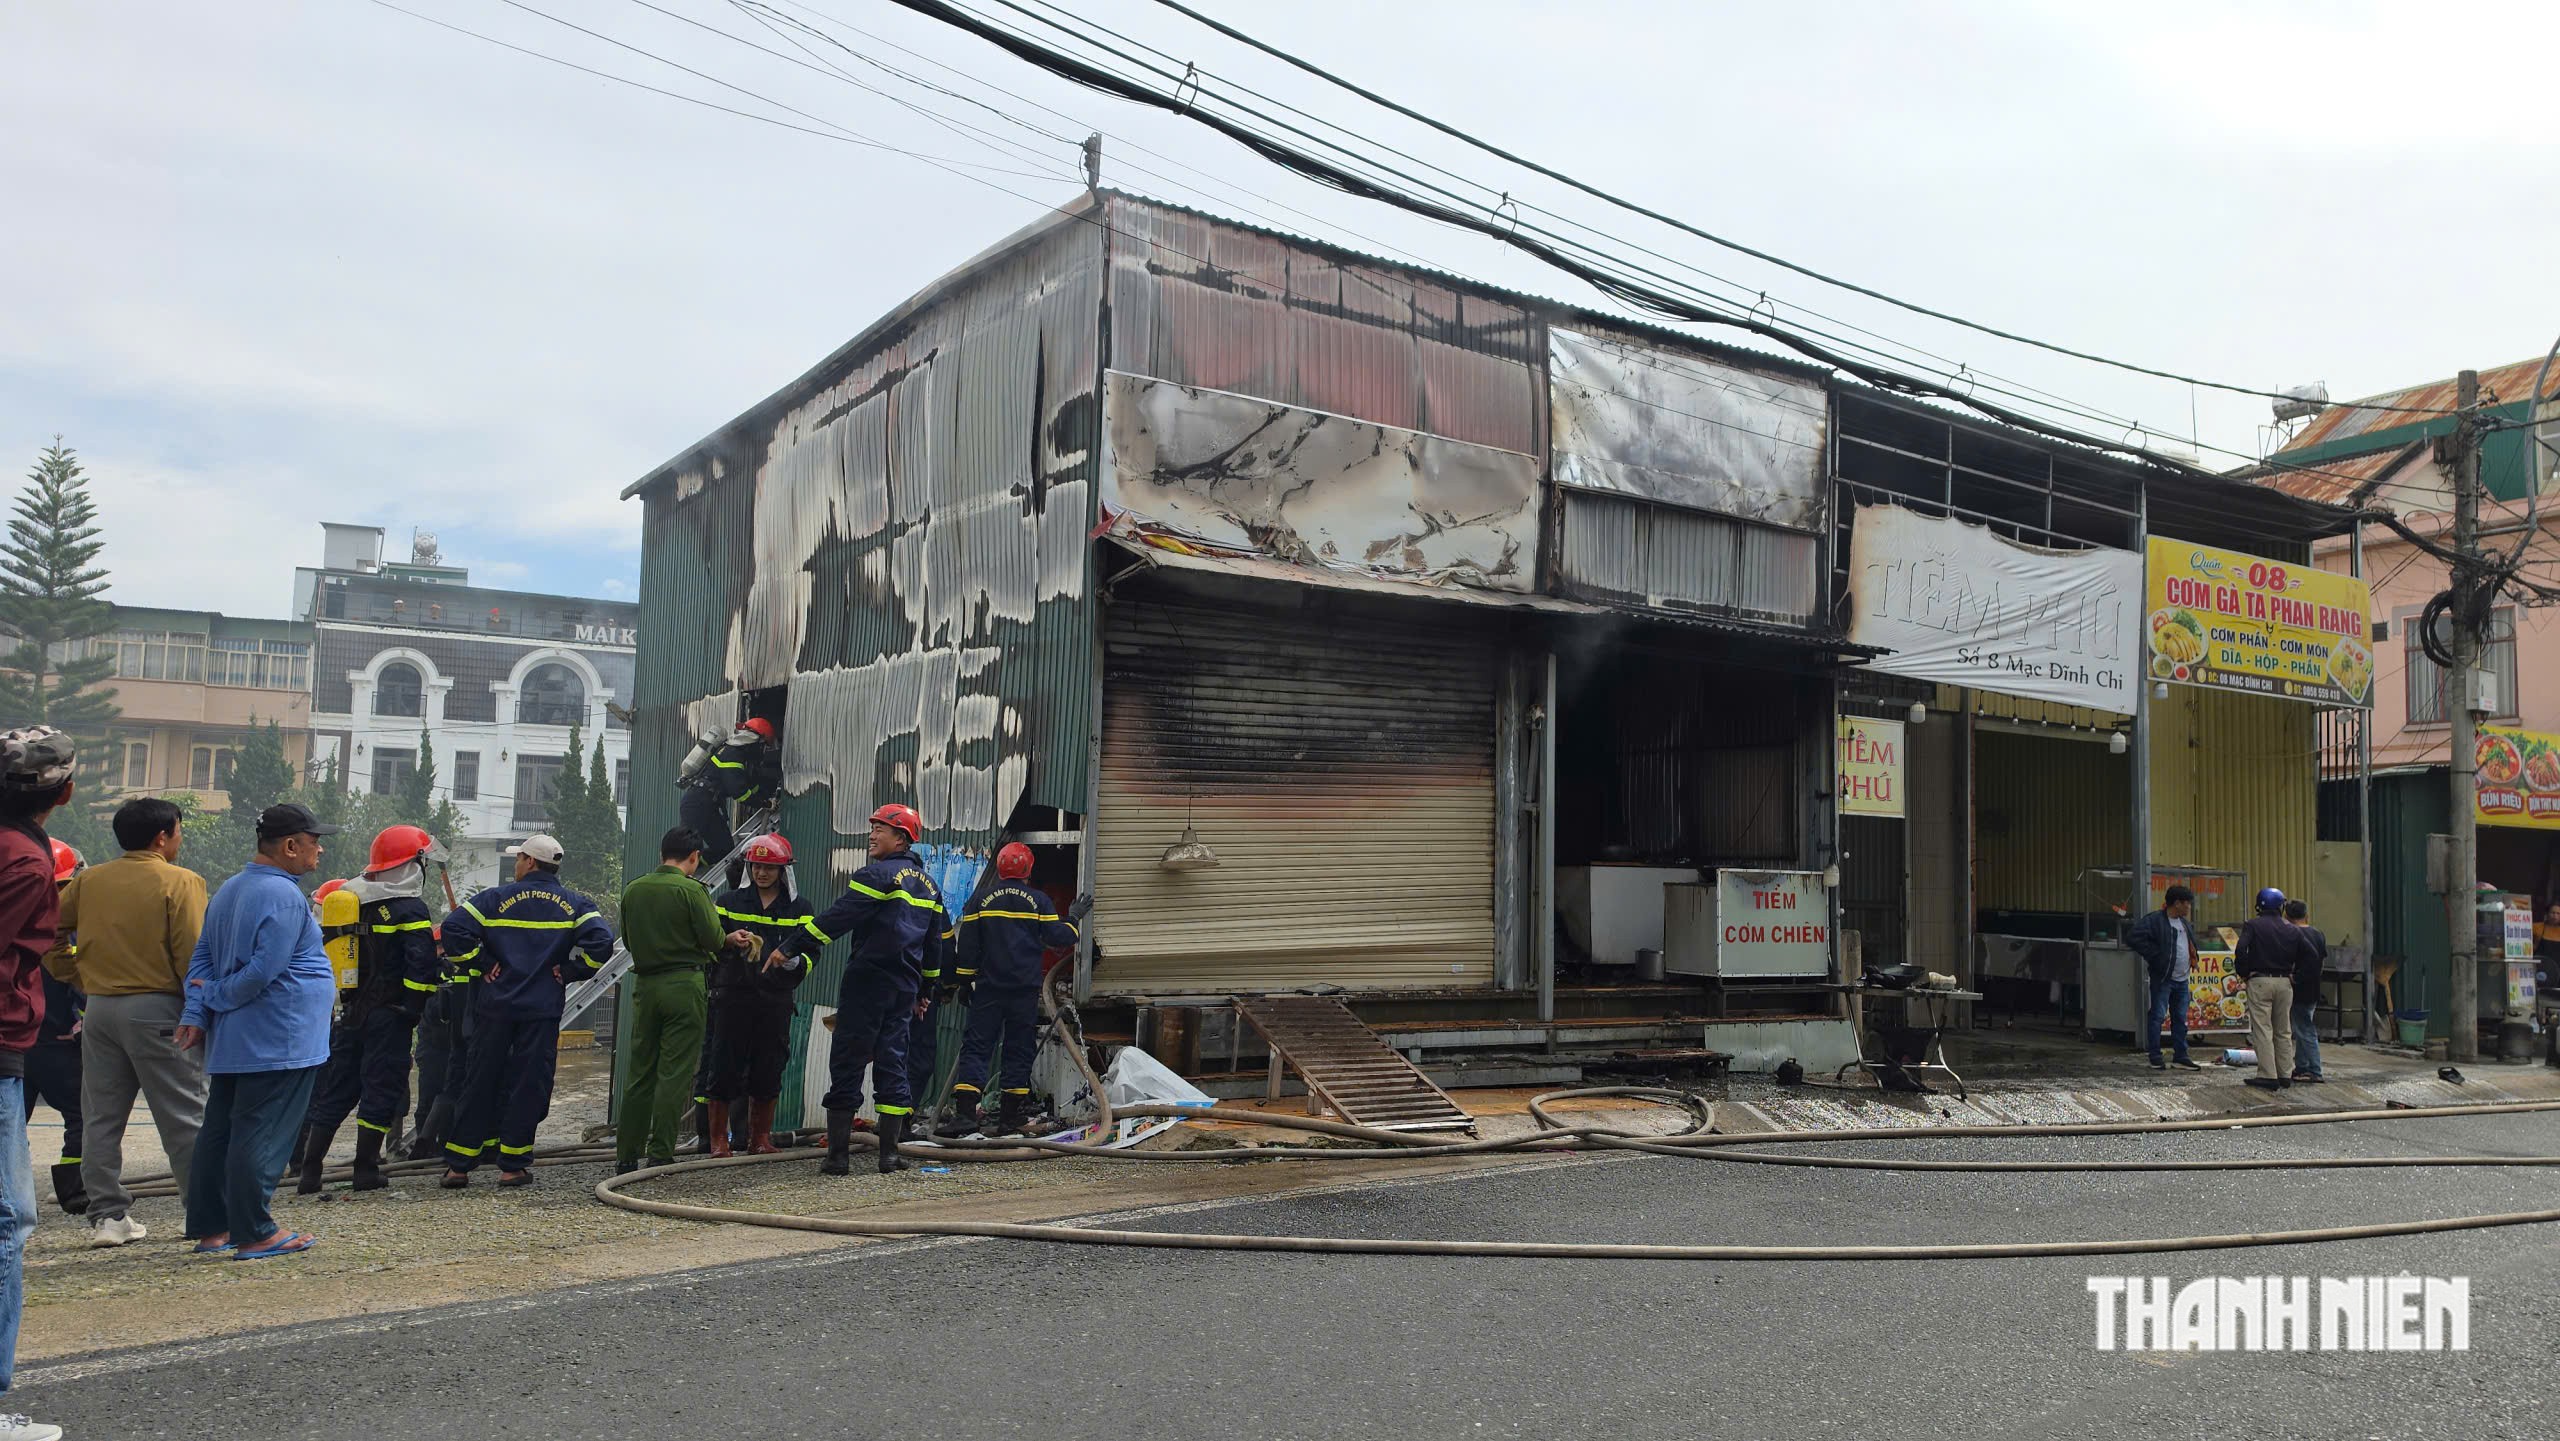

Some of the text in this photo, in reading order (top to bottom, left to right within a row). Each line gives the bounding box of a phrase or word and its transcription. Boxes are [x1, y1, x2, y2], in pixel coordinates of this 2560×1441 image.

[2249, 563, 2286, 592] 08
[2167, 576, 2361, 637] CƠM GÀ TA PHAN RANG
[2211, 627, 2235, 644] CƠM
[2280, 639, 2302, 655] CƠM
[1957, 646, 2124, 690] Số 8 Mạc Đĩnh Chi
[532, 890, 551, 900] PCCC
[1725, 921, 1825, 944] CƠM CHIÊN
[2202, 957, 2219, 973] TA
[2198, 975, 2219, 985] RANG
